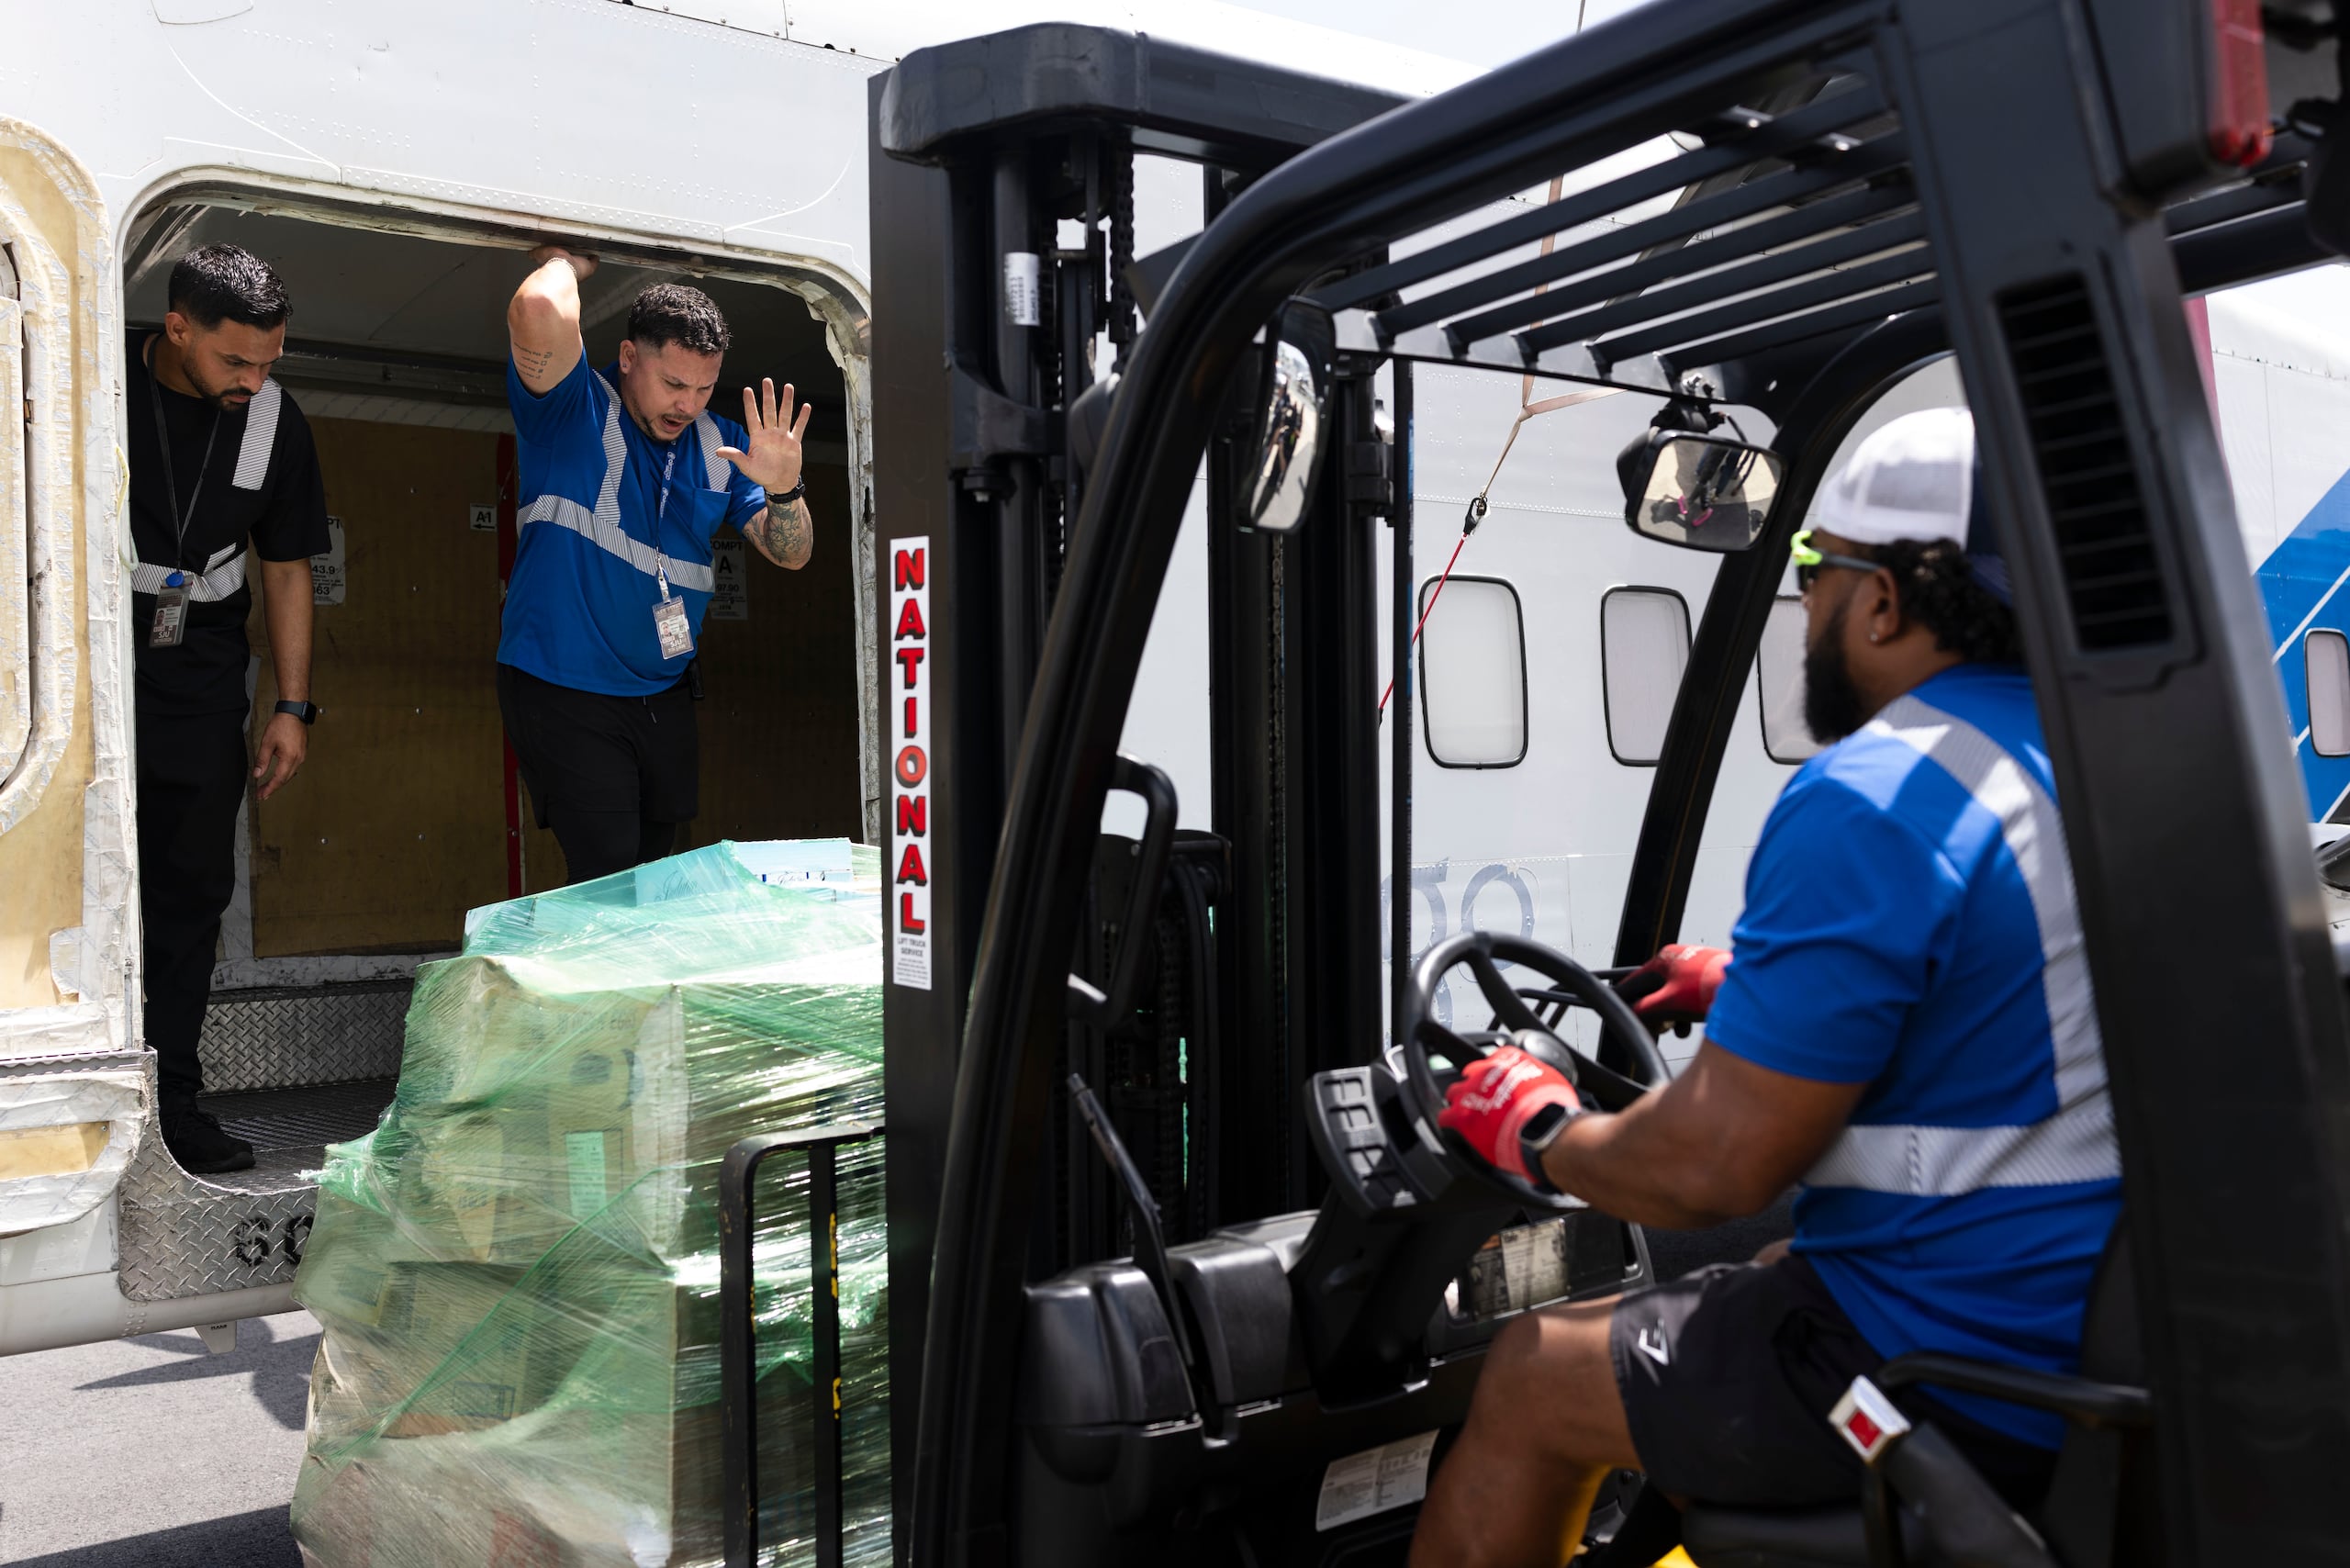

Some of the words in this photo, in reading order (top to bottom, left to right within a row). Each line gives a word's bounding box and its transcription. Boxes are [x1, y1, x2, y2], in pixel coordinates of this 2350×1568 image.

[711, 540, 744, 552] OMPT
[158, 631, 171, 639] SJU
[669, 637, 683, 649] SJU
[894, 548, 927, 935] NATIONAL
